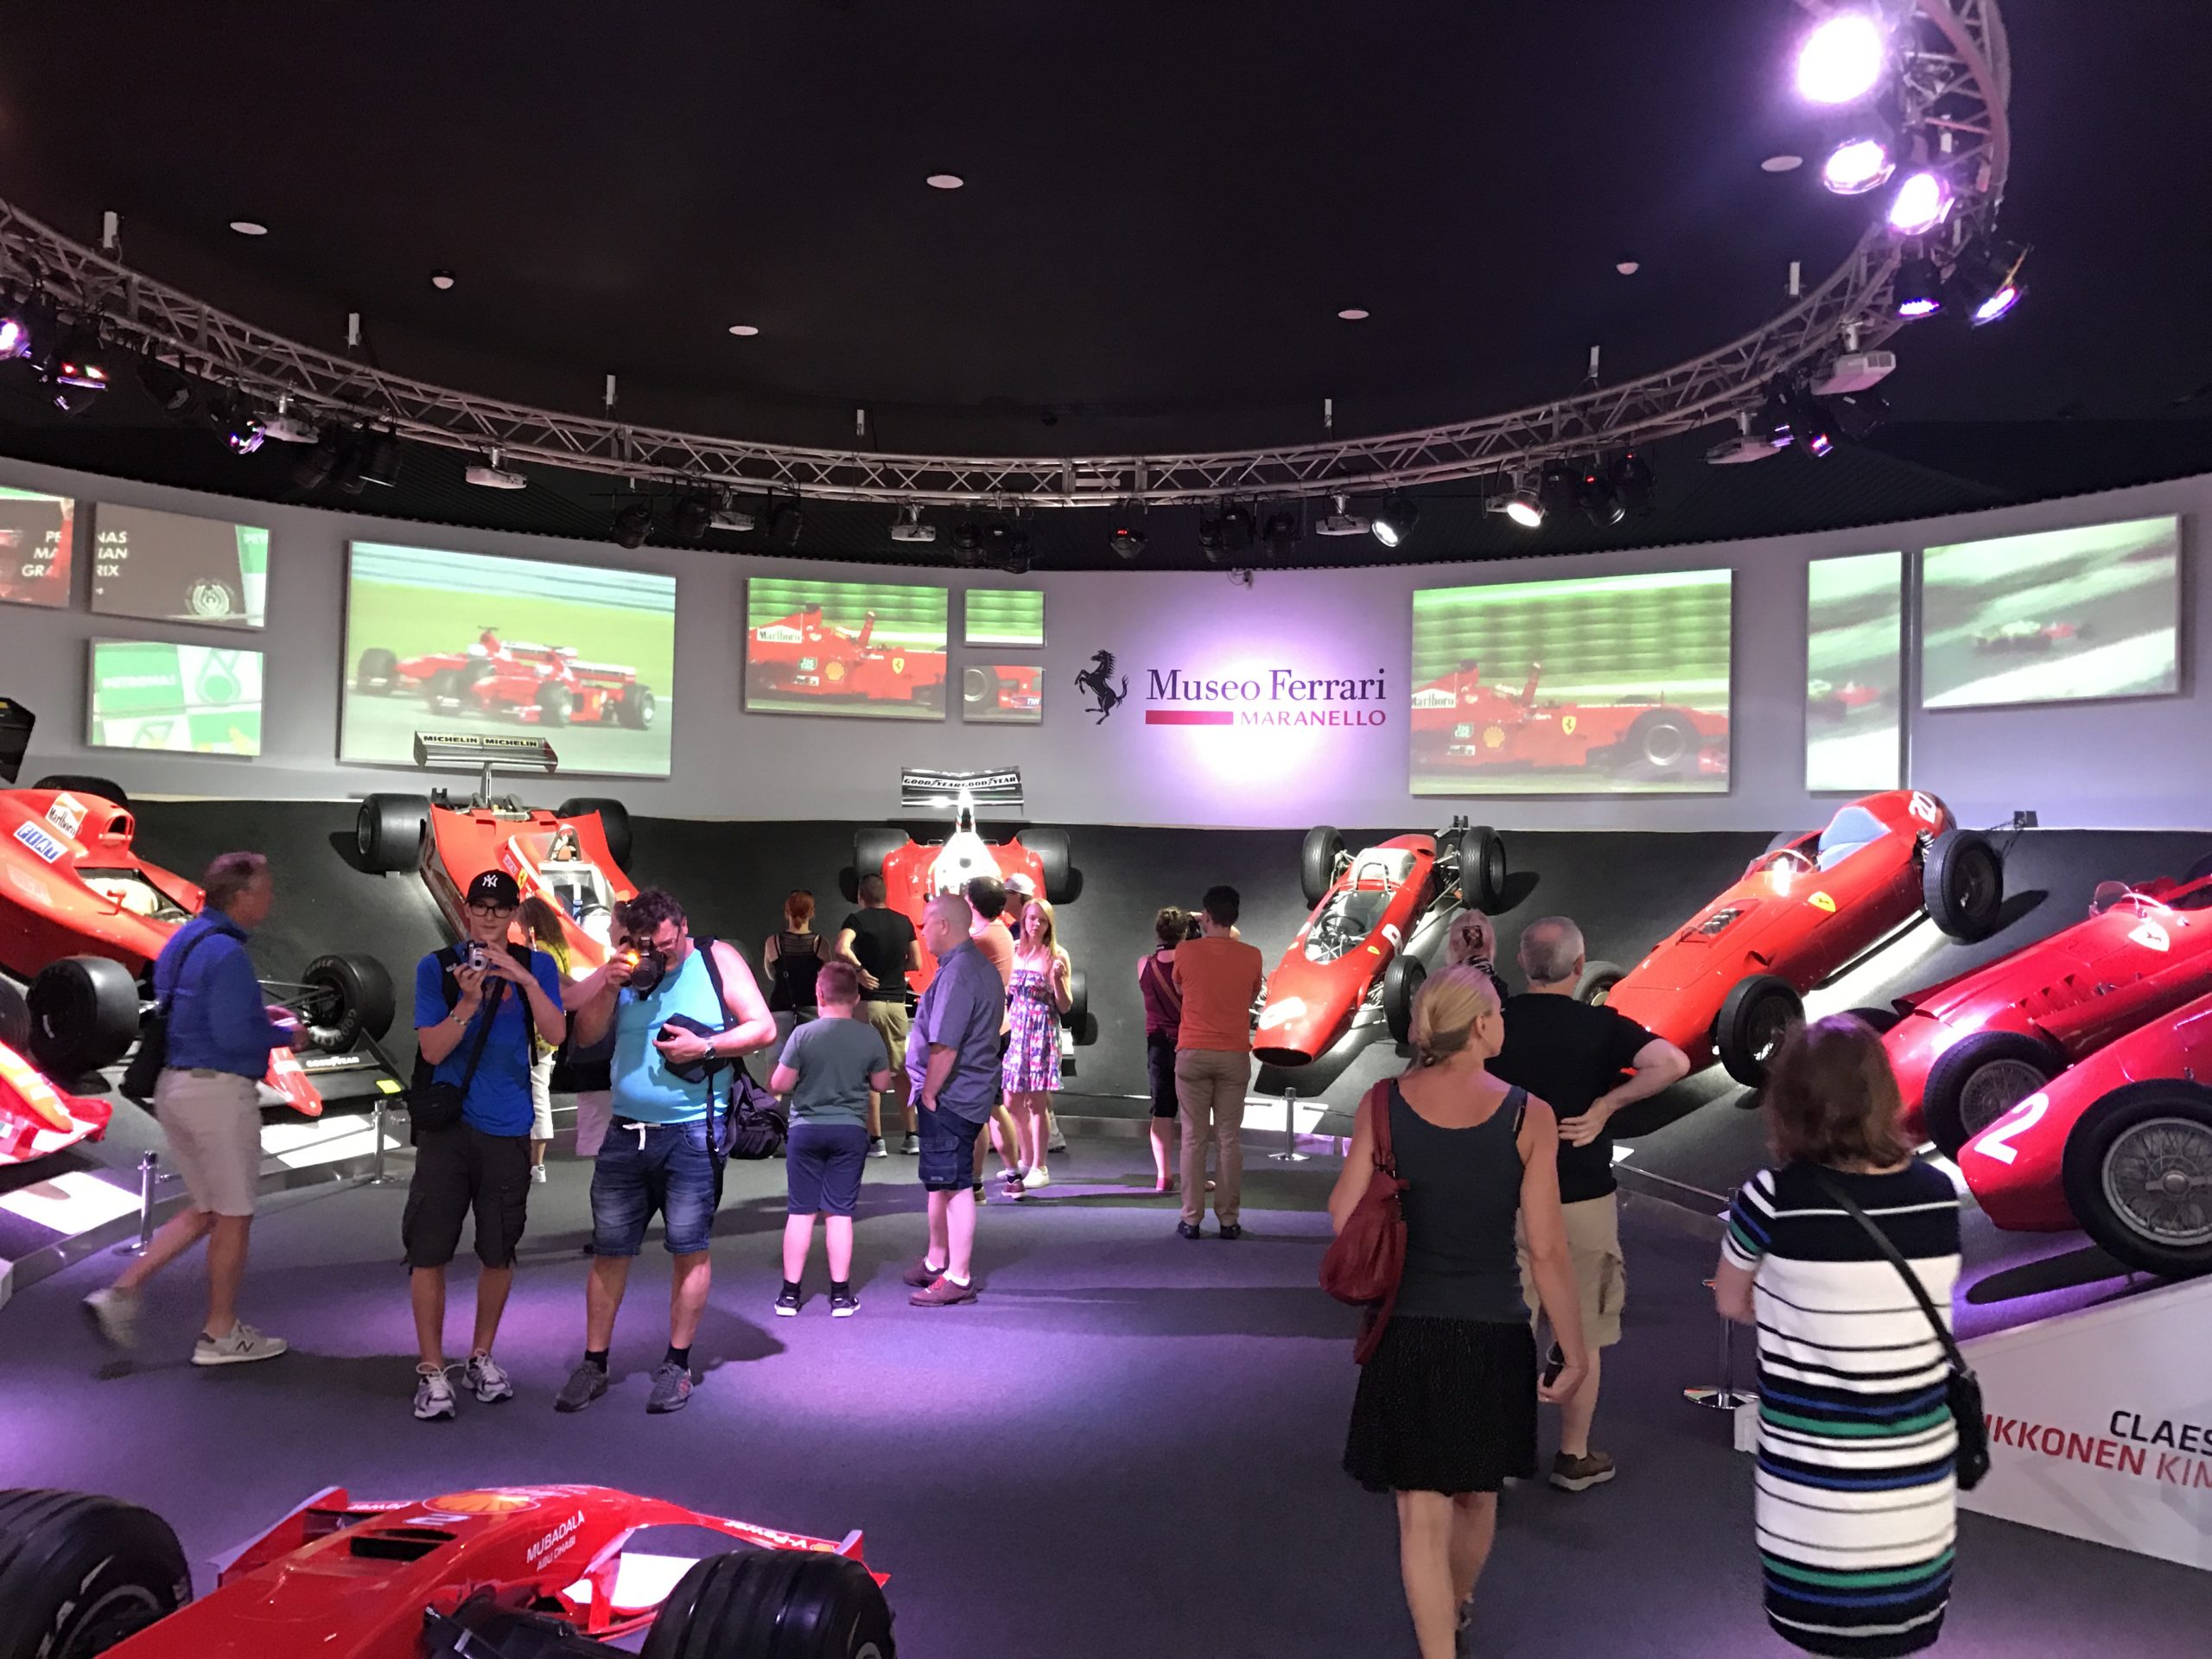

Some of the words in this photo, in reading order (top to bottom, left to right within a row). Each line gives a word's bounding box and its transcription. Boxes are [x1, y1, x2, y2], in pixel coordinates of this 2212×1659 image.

[1146, 669, 1260, 701] Museo
[1268, 668, 1386, 701] Ferrari
[1241, 710, 1386, 727] MARANELLO
[423, 735, 478, 744] MICHELIN
[485, 739, 537, 747] MICHELIN
[904, 779, 960, 788] GOODYEAR
[48, 807, 76, 836] Marlboro
[1908, 791, 1936, 824] 20
[16, 823, 60, 861] FIAT
[1974, 1092, 2050, 1166] 2
[526, 1510, 585, 1564] MUBADALA
[537, 1553, 554, 1572] ABU
[554, 1535, 576, 1560] DHABI
